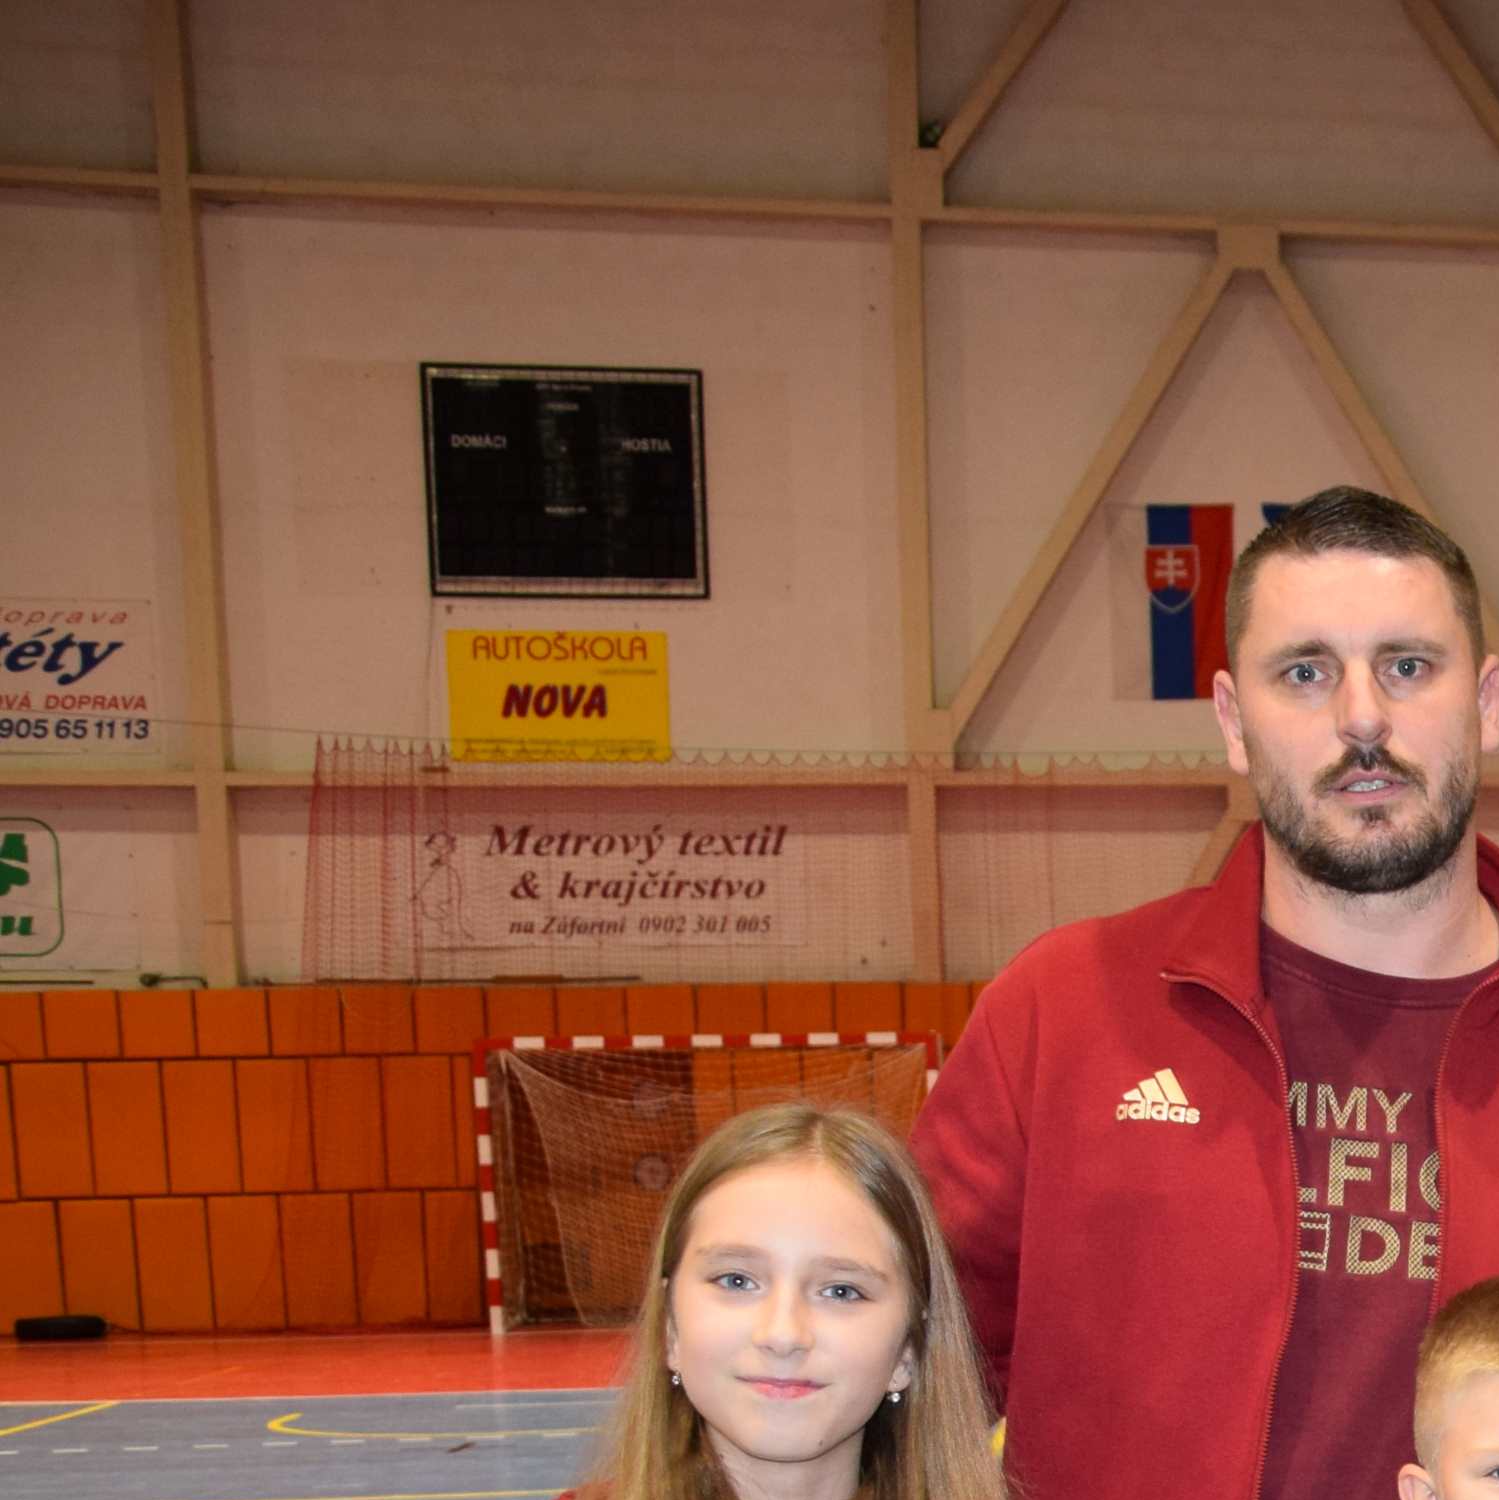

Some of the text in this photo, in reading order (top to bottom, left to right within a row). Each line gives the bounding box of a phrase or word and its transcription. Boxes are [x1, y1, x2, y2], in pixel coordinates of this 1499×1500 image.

[451, 433, 507, 449] DOMÁCI
[0, 609, 128, 627] oprava
[472, 631, 649, 661] AUTOŠKOLA
[45, 694, 148, 710] DOPRAVA
[502, 684, 608, 719] NOVA
[55, 719, 88, 740] 65
[485, 824, 788, 864] Metrový textil
[510, 870, 767, 907] & krajčírstvo
[509, 921, 534, 935] na
[638, 916, 687, 935] 0902
[1116, 1099, 1201, 1124] adidas
